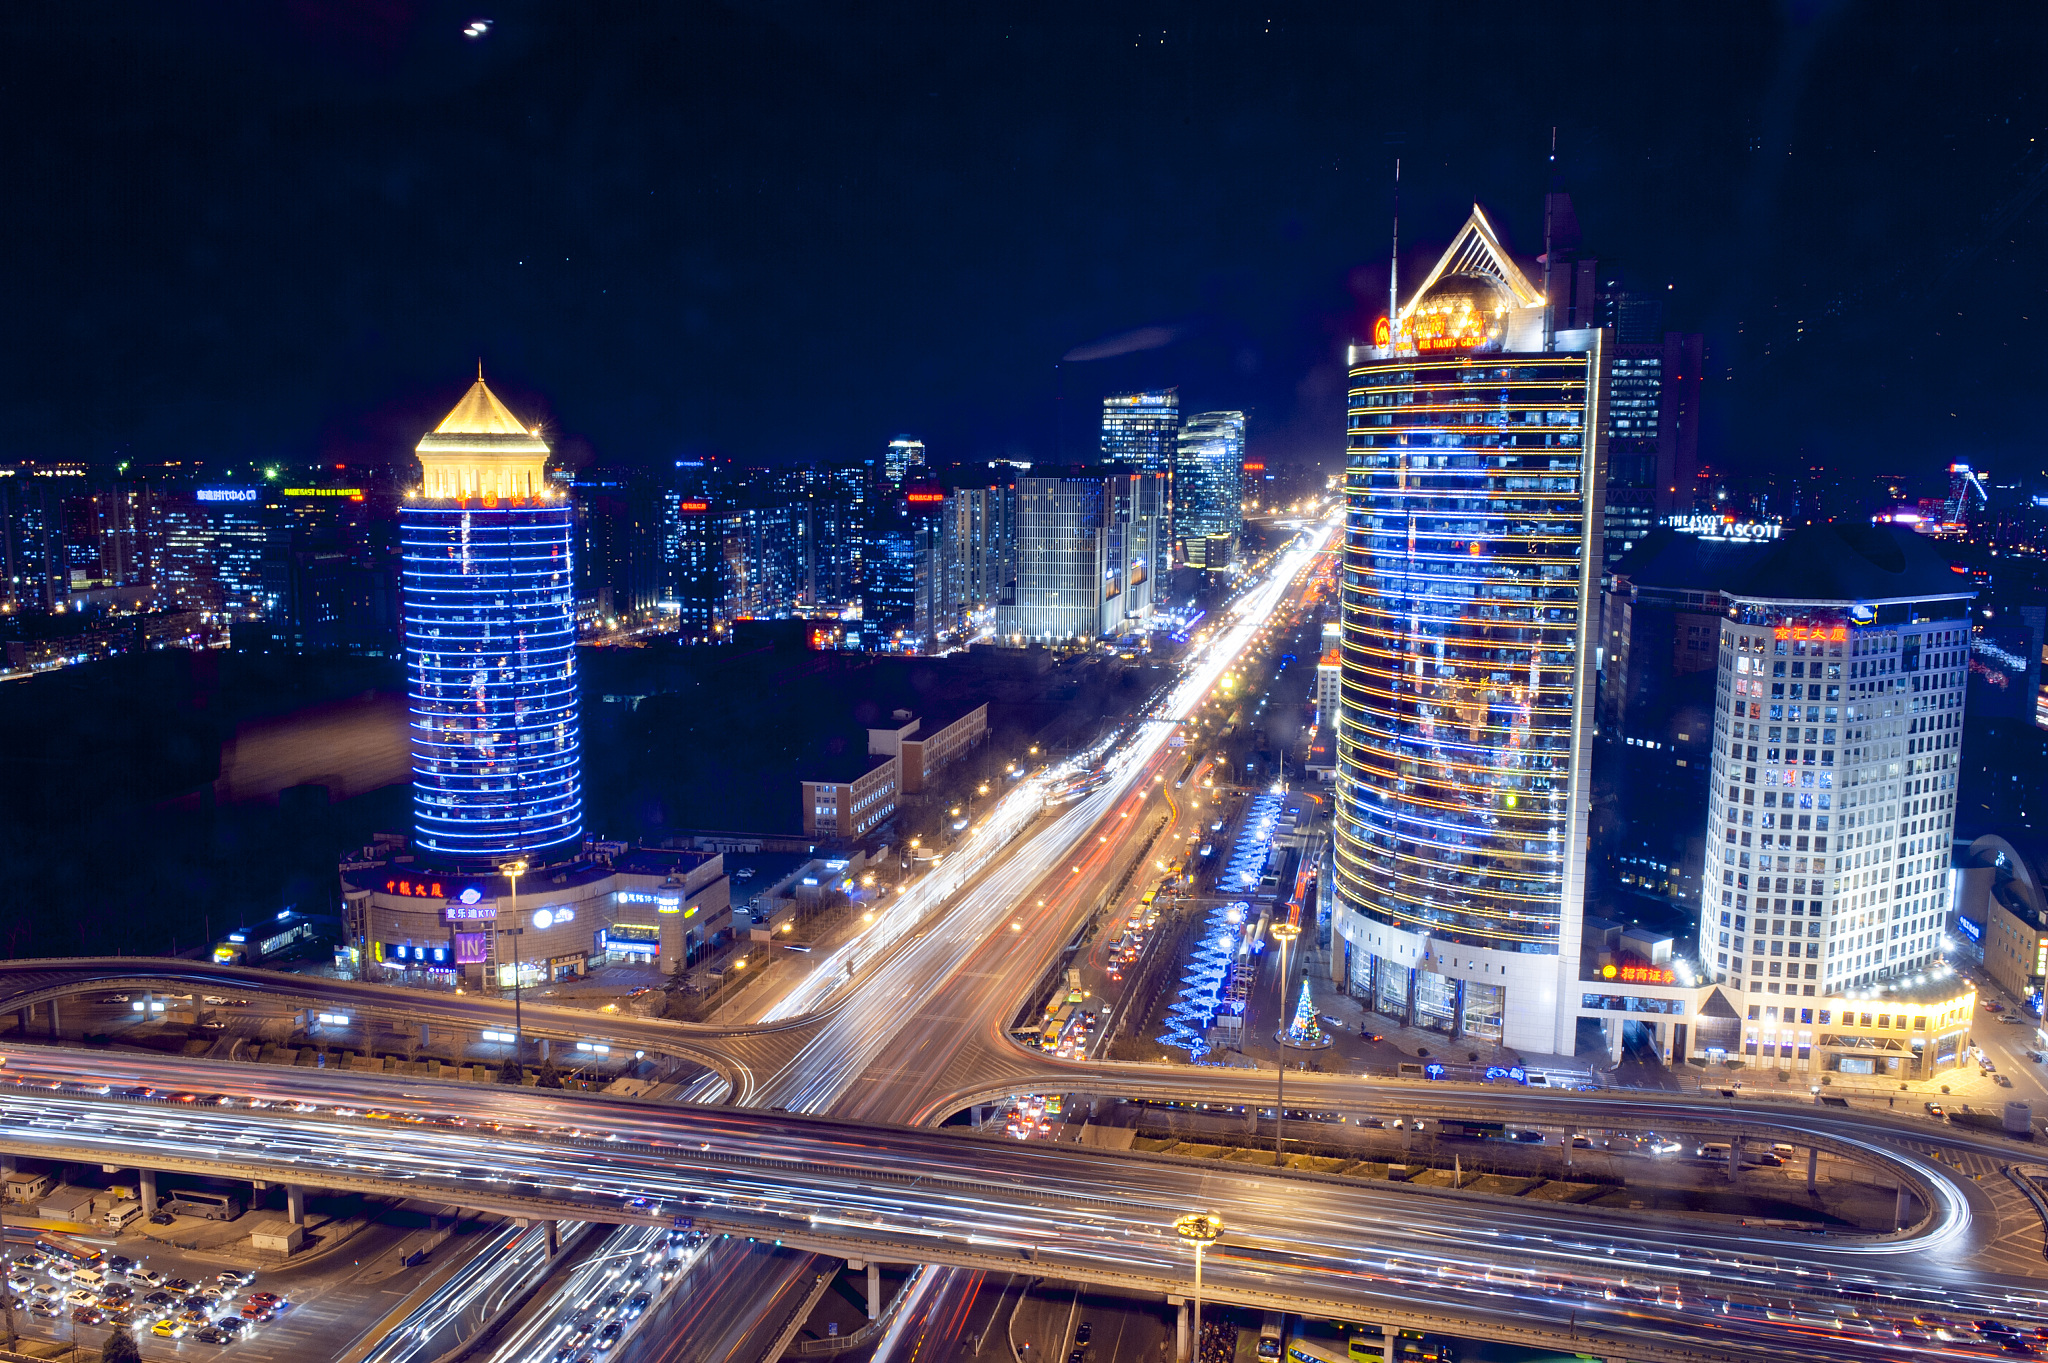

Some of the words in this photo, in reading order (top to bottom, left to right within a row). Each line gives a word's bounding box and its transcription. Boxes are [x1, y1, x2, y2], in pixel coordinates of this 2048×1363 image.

[1668, 516, 1688, 527] THE
[1723, 523, 1781, 538] ASCOTT
[1774, 627, 1847, 641] 京汇大厦
[387, 880, 443, 898] 中服大厦
[461, 940, 479, 956] IN
[1621, 966, 1675, 983] 招商证券
